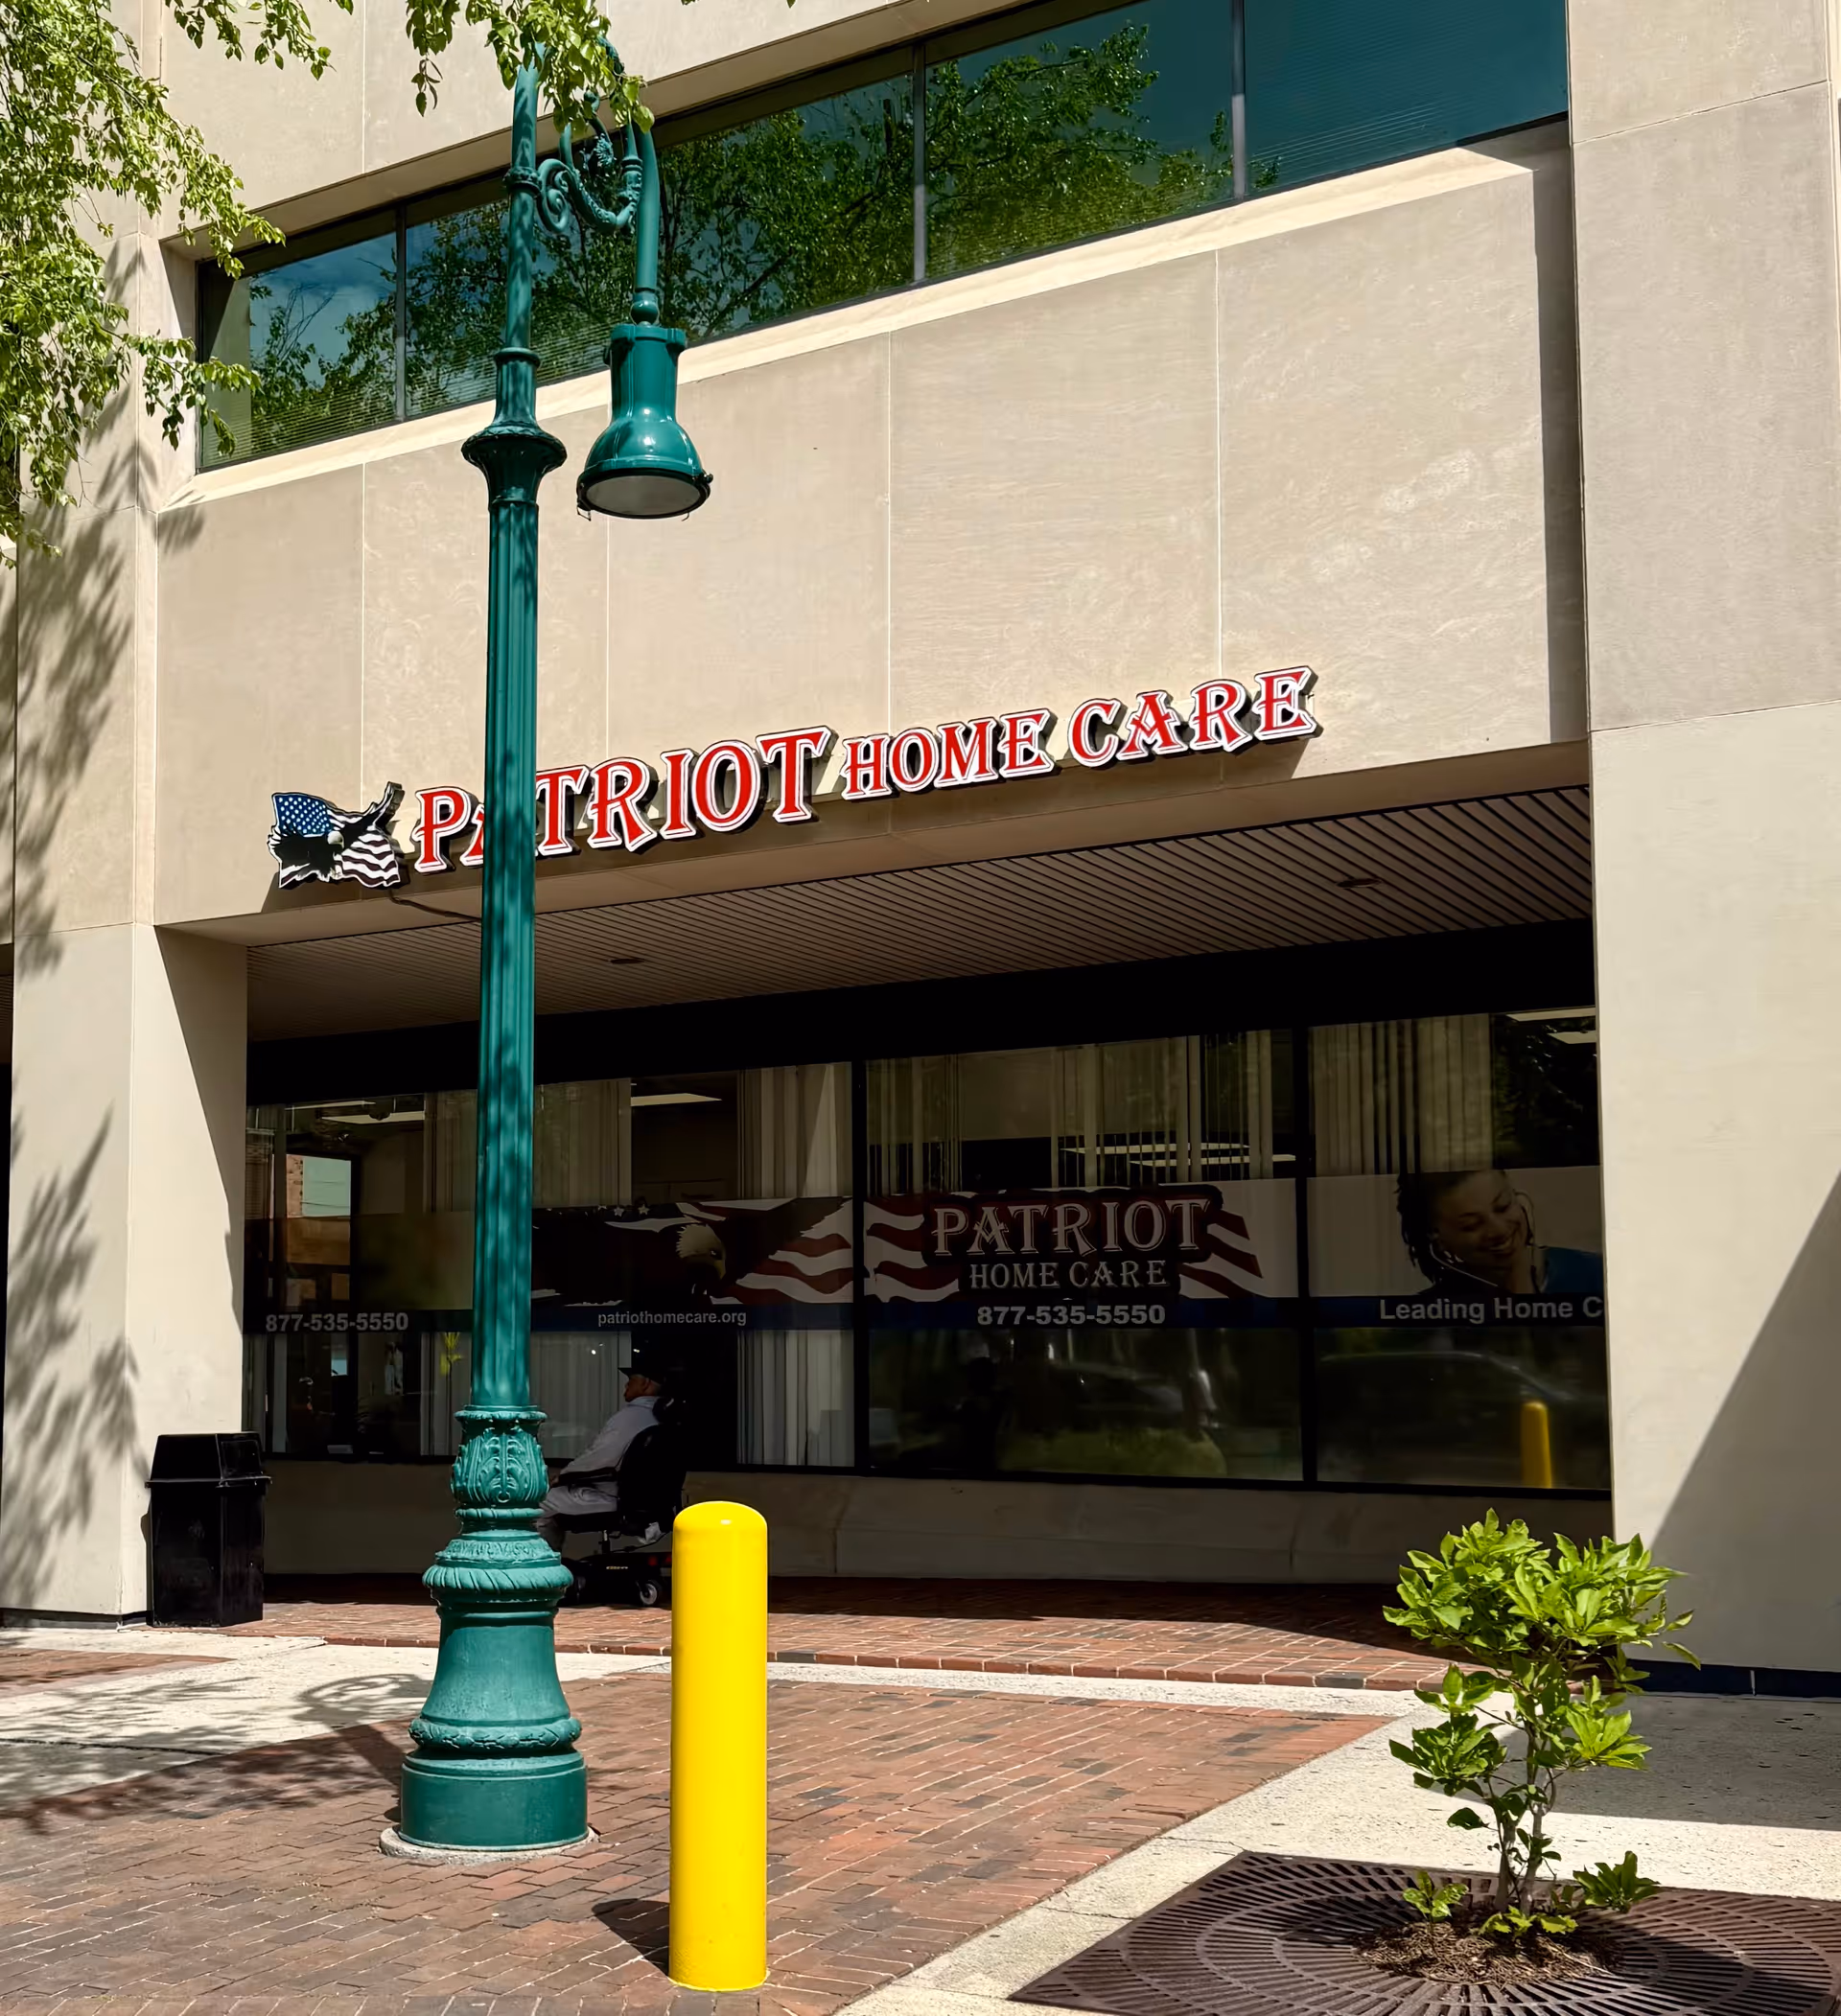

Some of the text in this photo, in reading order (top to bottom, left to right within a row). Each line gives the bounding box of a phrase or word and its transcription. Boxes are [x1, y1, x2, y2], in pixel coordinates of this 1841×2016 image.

[411, 665, 1317, 873] PTRIOT HOME CARE
[930, 1198, 1212, 1257] PATRIOT
[969, 1259, 1171, 1290] HOME CARE
[266, 1311, 409, 1332] 877-535-5550
[597, 1310, 747, 1327] patriothomecare.org
[976, 1304, 1167, 1326] 877-535-5550
[1379, 1297, 1485, 1325] Leading
[1493, 1296, 1573, 1320] Home
